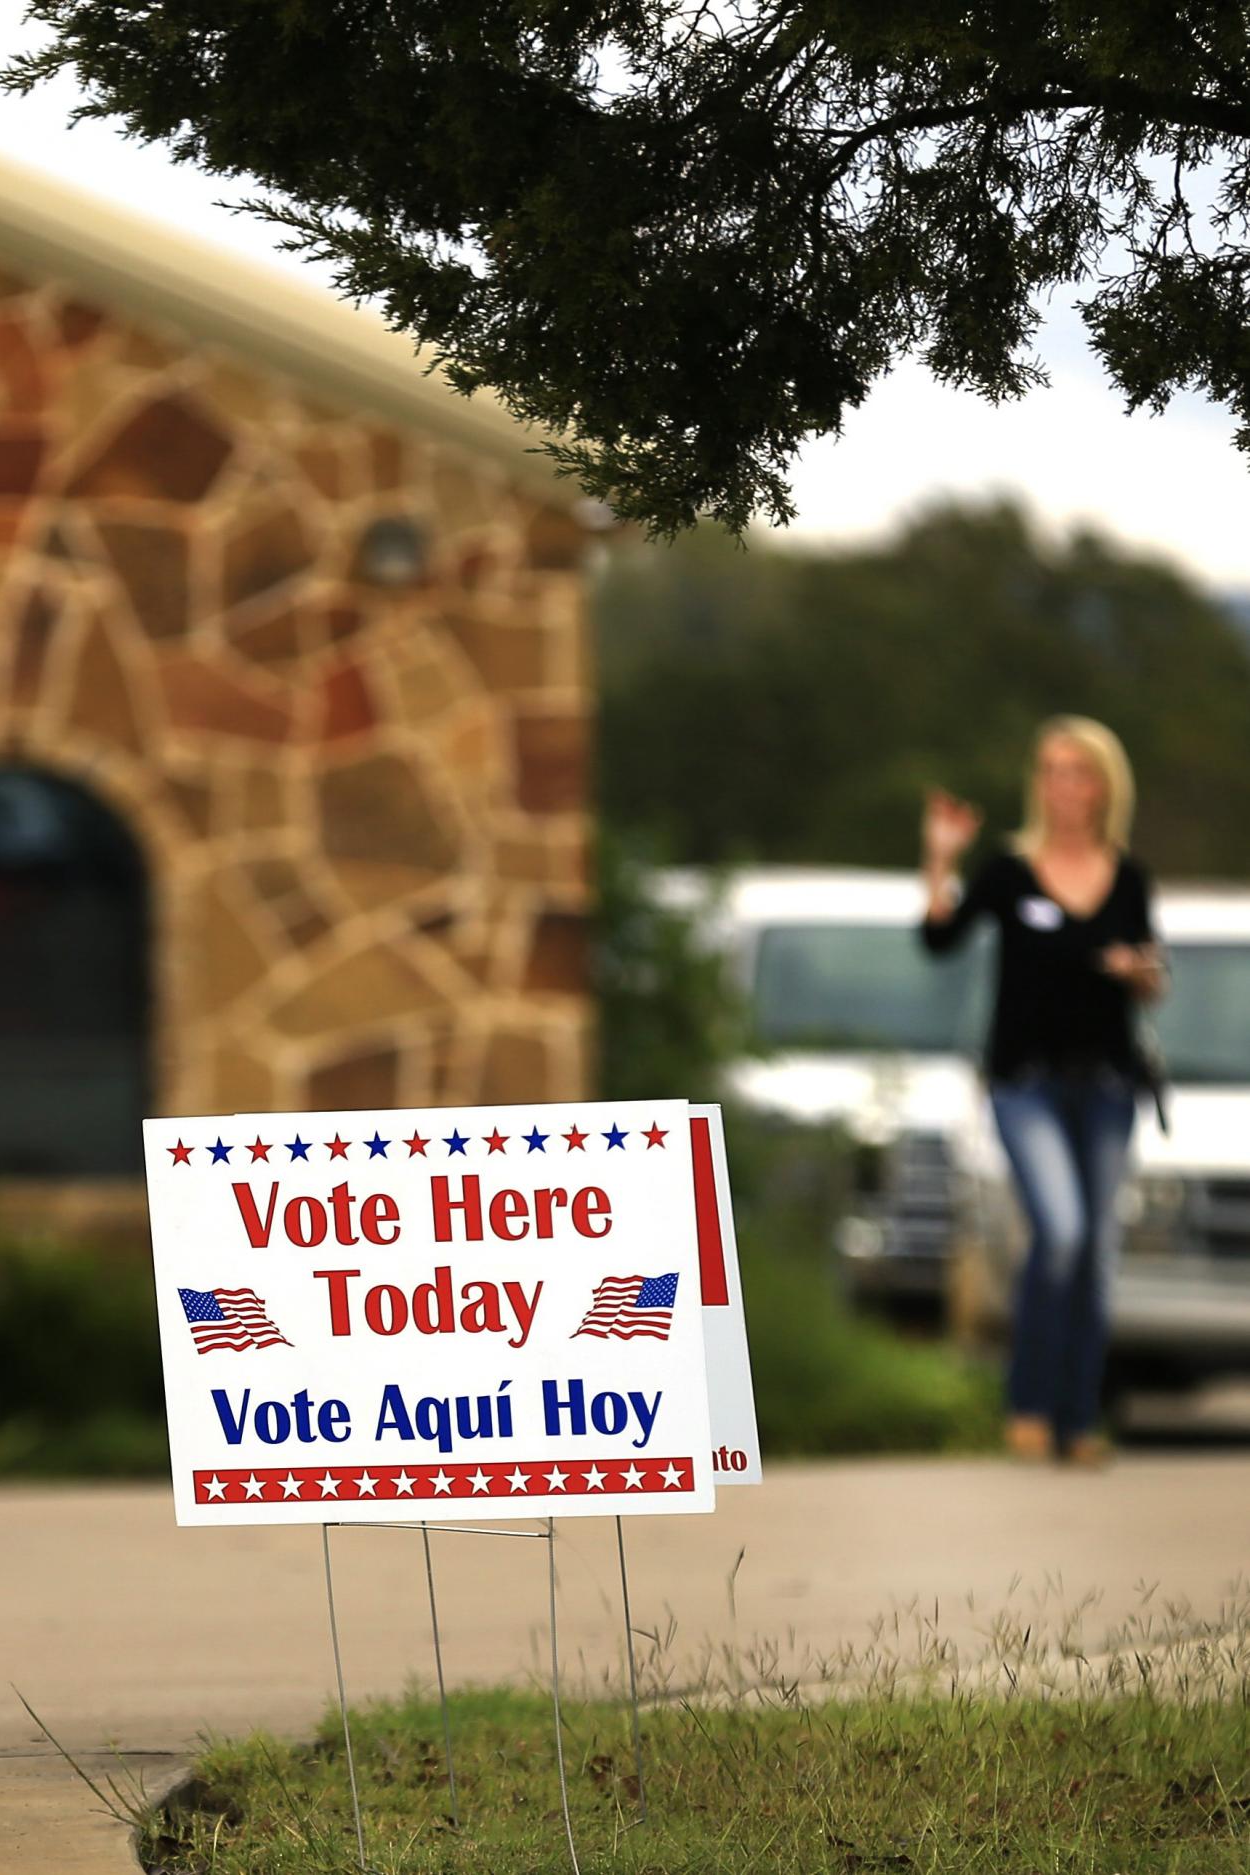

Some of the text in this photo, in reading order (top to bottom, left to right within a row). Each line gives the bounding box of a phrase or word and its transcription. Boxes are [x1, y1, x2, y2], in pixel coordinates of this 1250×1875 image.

[231, 1174, 613, 1249] Vote Here
[312, 1265, 544, 1349] Today
[210, 1378, 663, 1454] Vote Aquí Hoy
